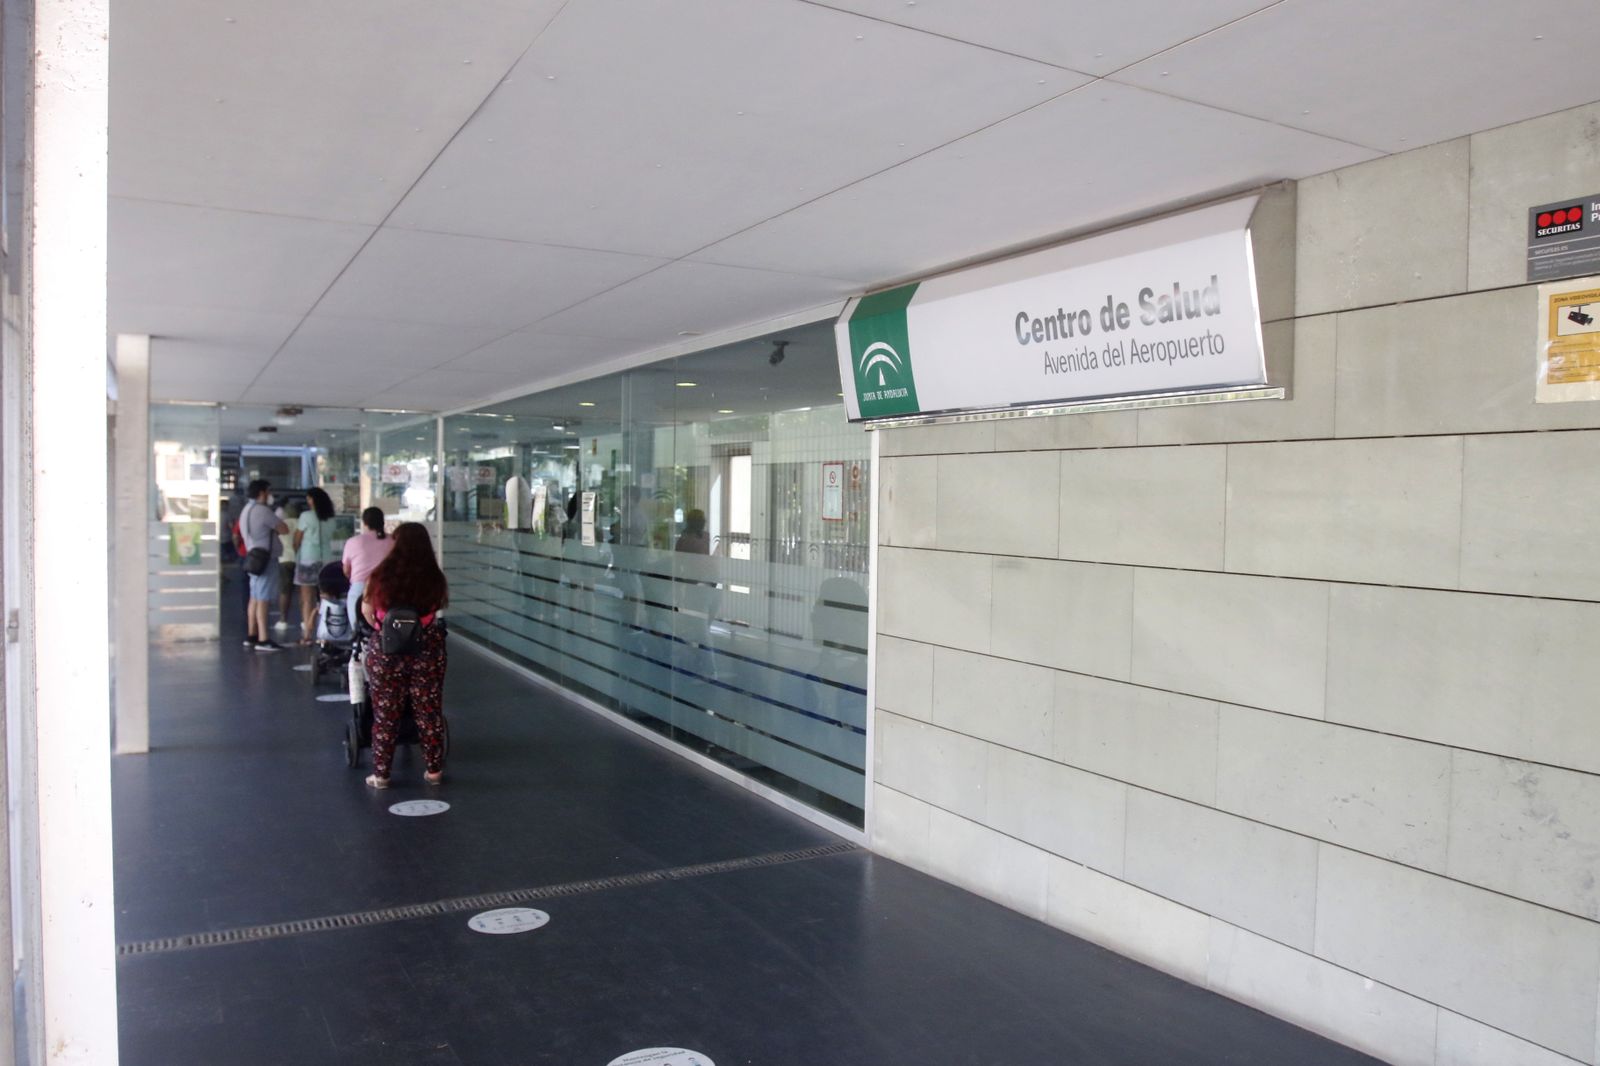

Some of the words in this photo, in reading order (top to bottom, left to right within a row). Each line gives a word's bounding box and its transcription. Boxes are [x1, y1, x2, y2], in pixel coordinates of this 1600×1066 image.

[1537, 222, 1581, 236] SECURITAS
[1015, 308, 1092, 346] Centro
[1100, 295, 1131, 333] de
[1138, 275, 1221, 326] Salud
[1044, 346, 1099, 375] Avenida
[1103, 340, 1126, 368] del
[1130, 328, 1225, 366] Aeropuerto
[863, 391, 876, 401] JUNTA
[877, 390, 883, 400] DE
